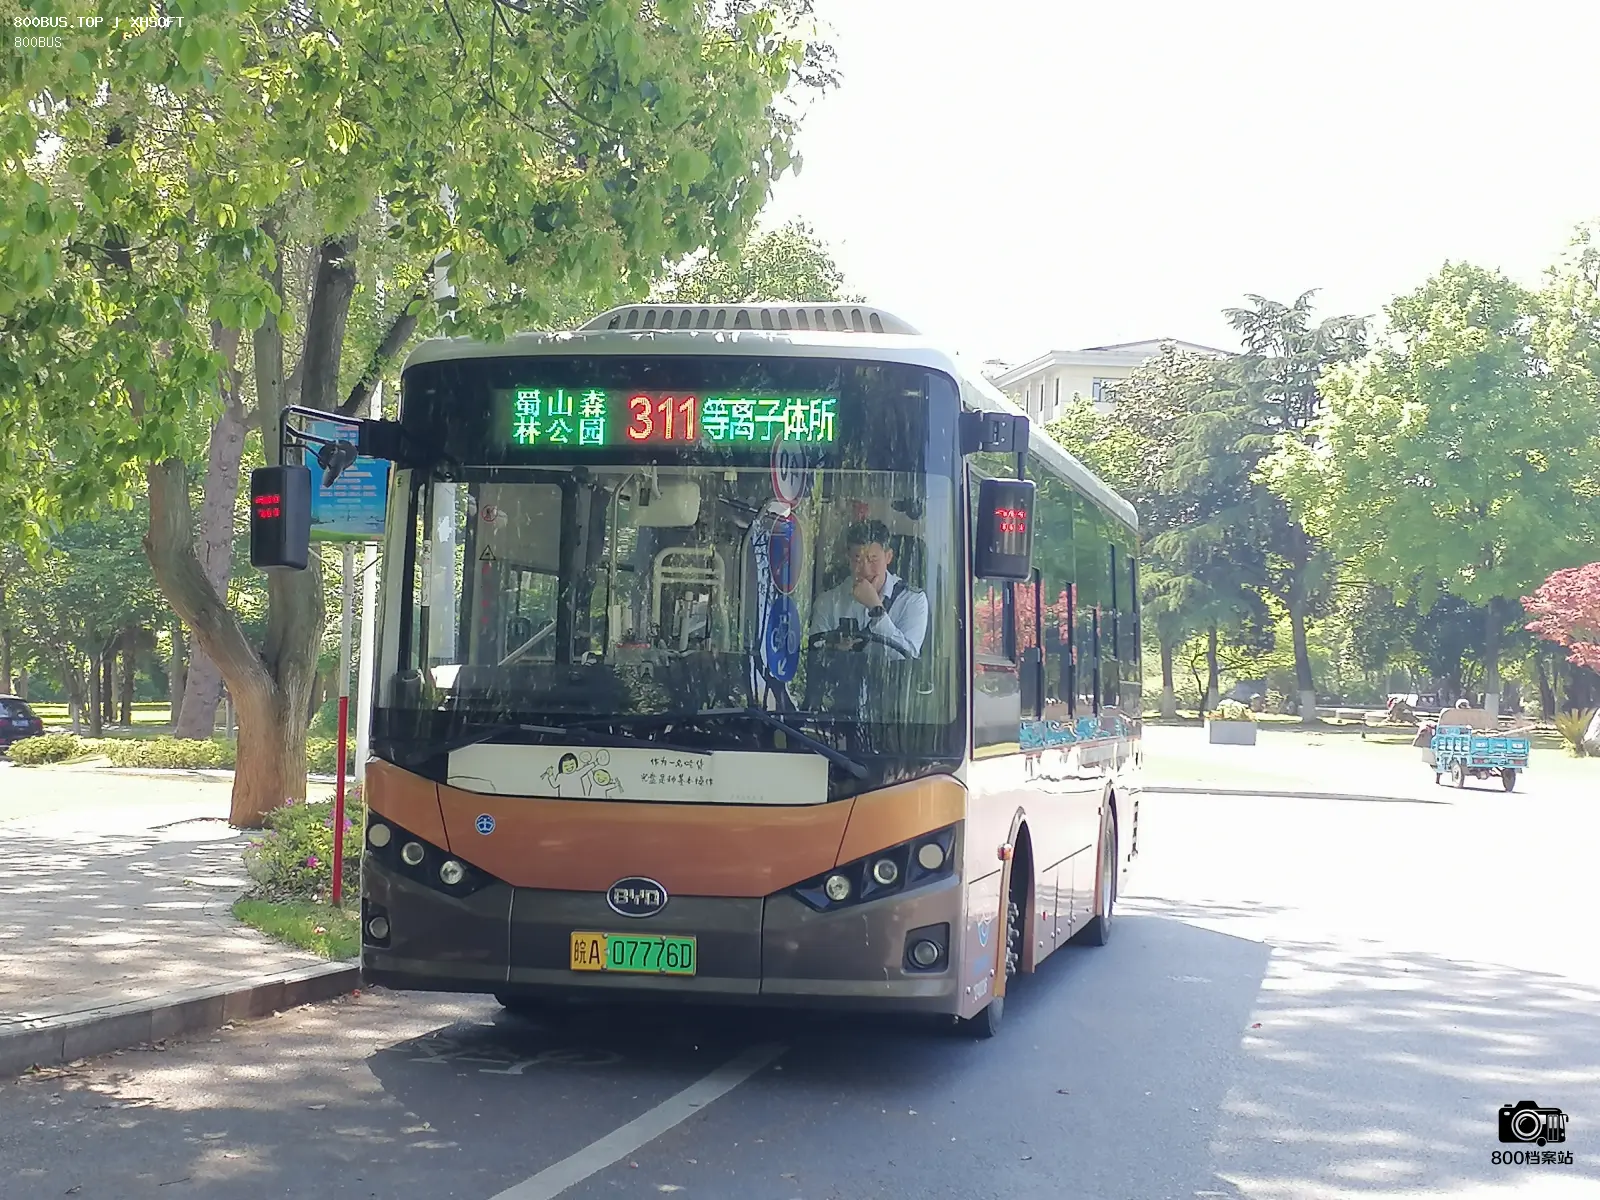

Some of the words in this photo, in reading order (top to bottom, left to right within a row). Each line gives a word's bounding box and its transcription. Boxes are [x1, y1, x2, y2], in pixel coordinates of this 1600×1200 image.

[514, 389, 606, 417] 蜀山森
[628, 395, 697, 441] 311
[513, 416, 606, 446] 林公园
[702, 397, 837, 442] 等离子体所
[613, 887, 660, 906] BYD
